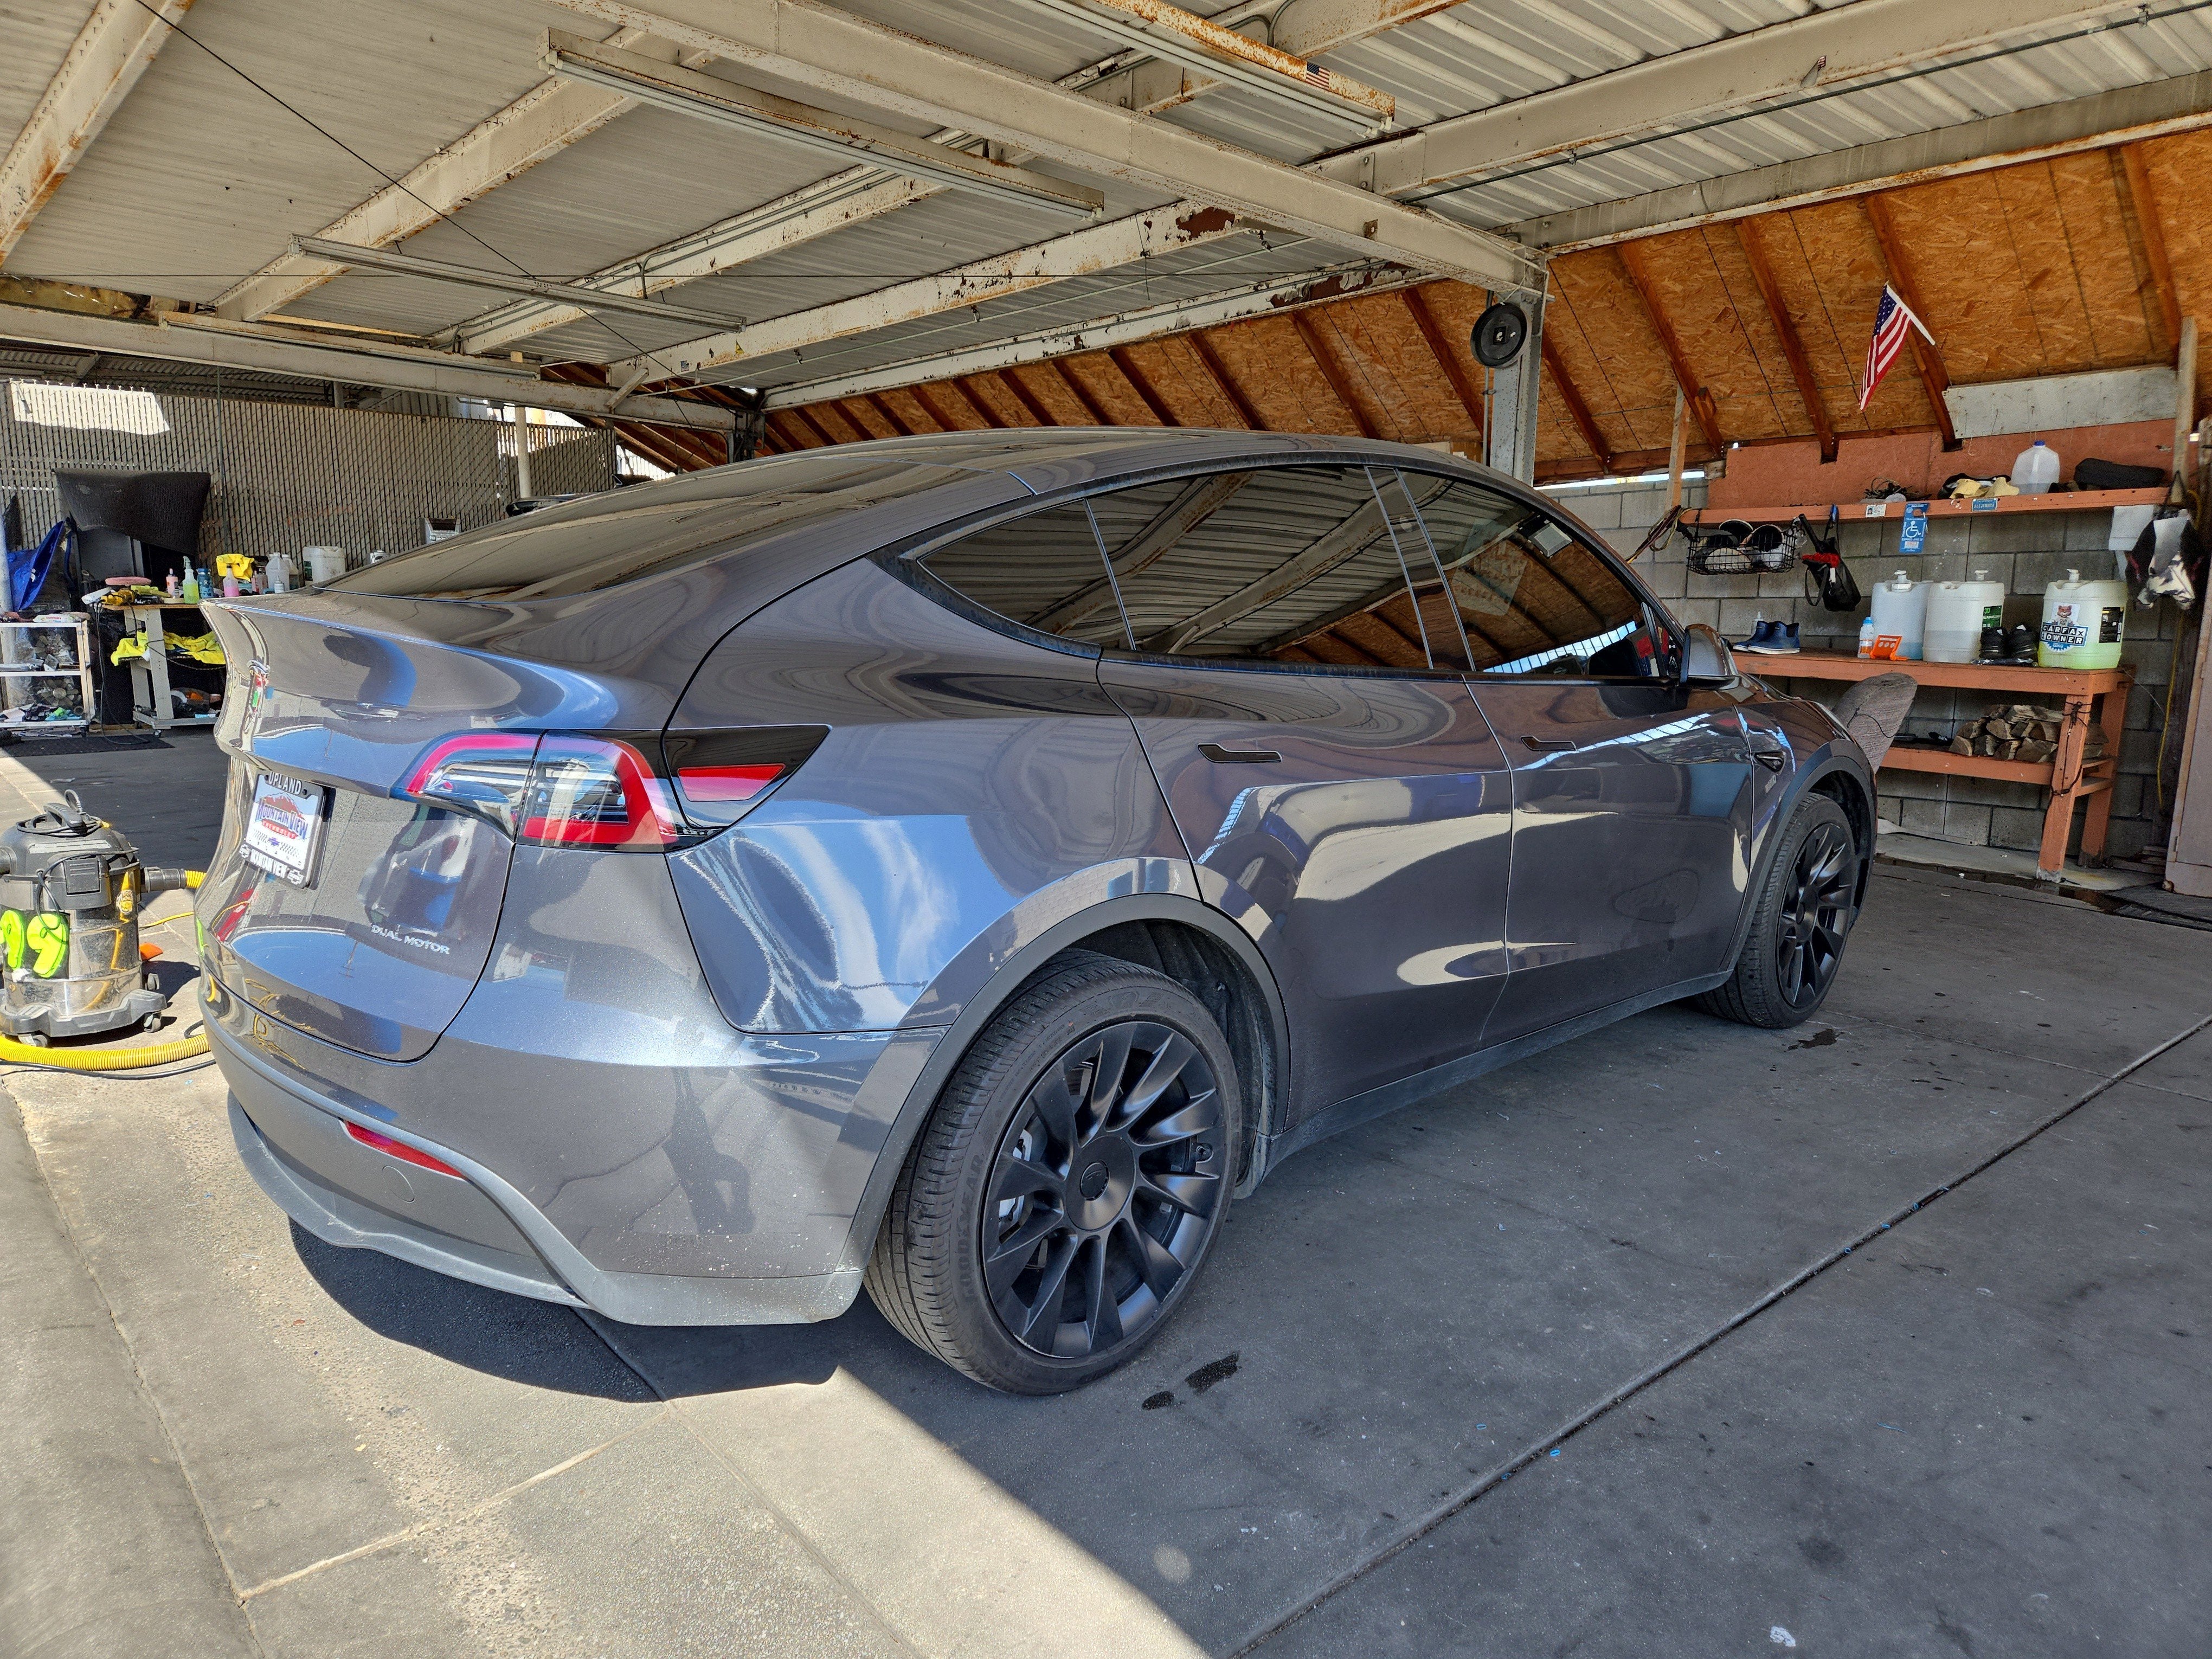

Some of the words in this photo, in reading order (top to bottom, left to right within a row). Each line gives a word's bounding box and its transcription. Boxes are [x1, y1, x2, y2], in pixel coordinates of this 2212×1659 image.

[2043, 625, 2085, 636] CARFAX
[269, 770, 302, 795] UPLAND
[255, 798, 289, 826] MOUNTAIN
[288, 811, 308, 840] VIEW
[371, 924, 402, 942] DUAL
[404, 935, 450, 955] MOTOR
